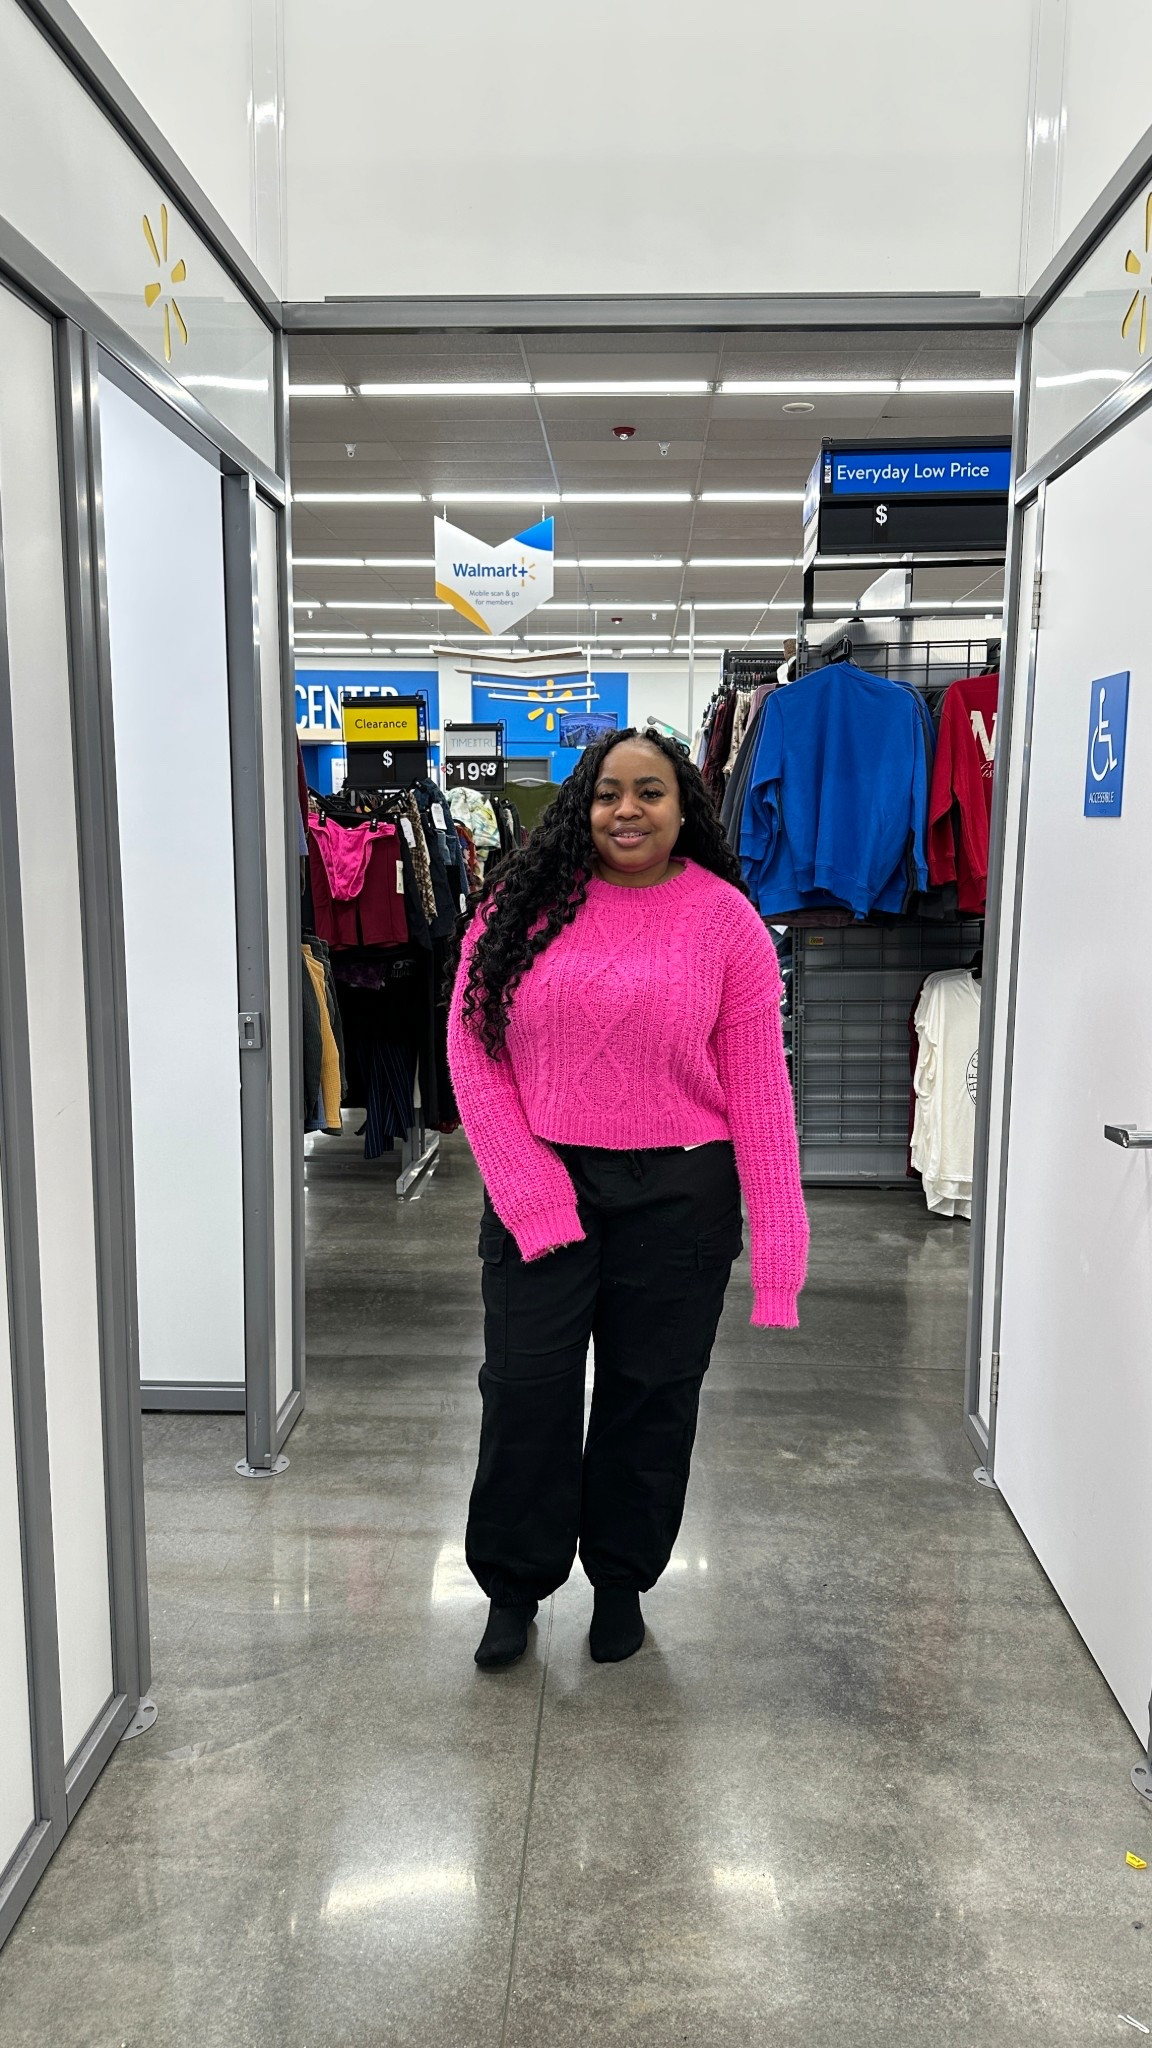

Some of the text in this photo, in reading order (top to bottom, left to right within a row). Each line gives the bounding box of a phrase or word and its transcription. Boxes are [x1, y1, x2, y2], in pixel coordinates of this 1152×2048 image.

[837, 463, 909, 484] Everyday
[914, 463, 946, 479] Low
[950, 462, 990, 478] Price
[875, 504, 888, 526] $
[294, 684, 399, 729] CEN
[354, 718, 408, 729] Clearance
[451, 738, 472, 747] TIME
[382, 749, 393, 768] $
[1088, 791, 1115, 804] ACCESSIBLE
